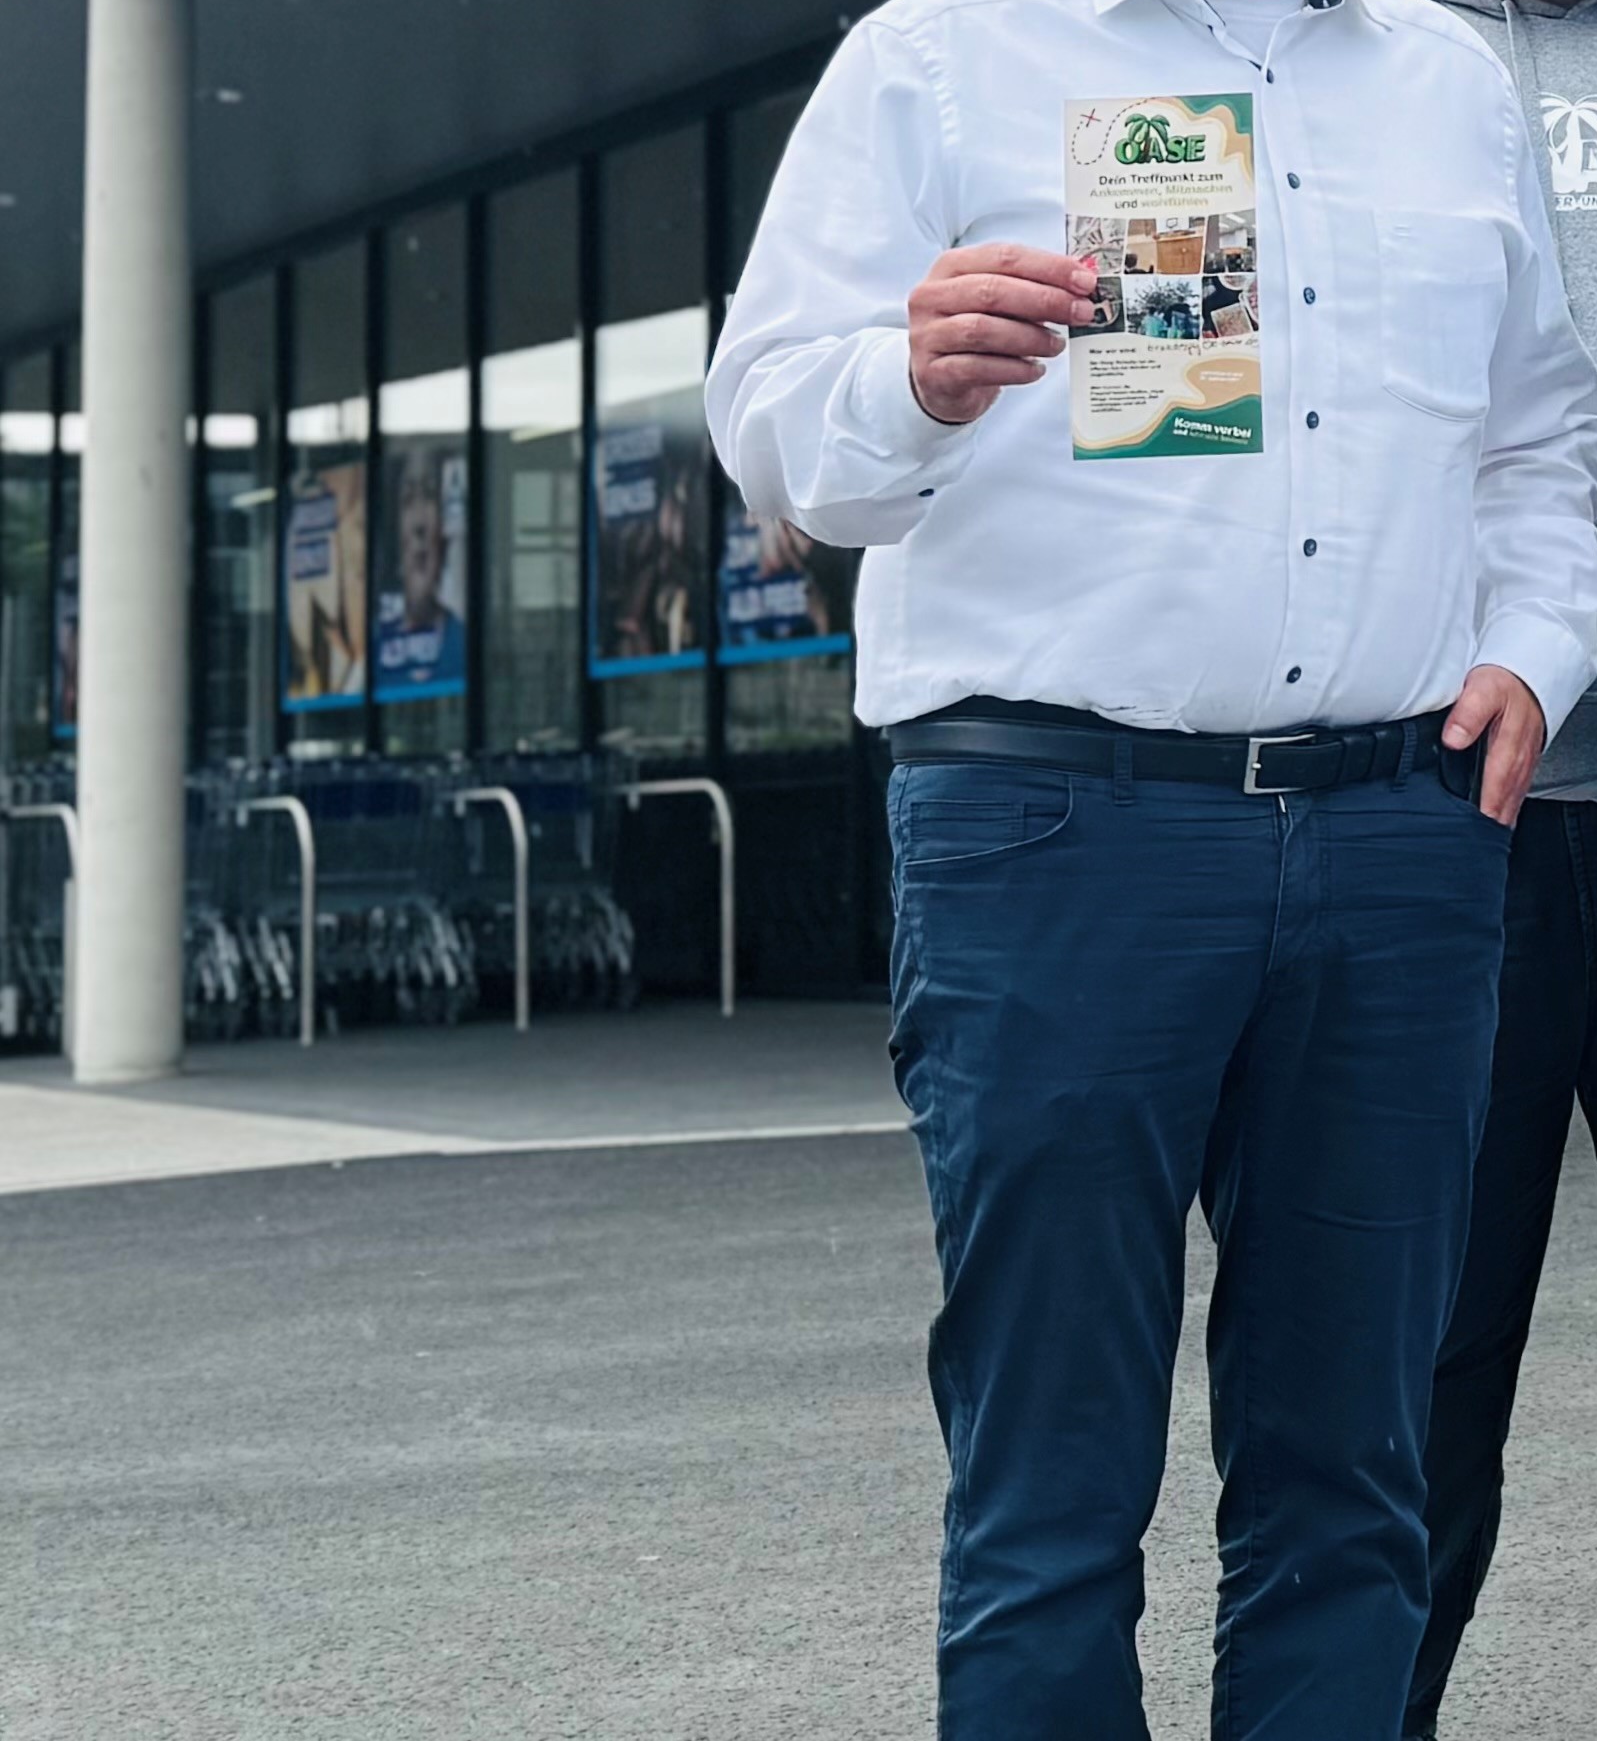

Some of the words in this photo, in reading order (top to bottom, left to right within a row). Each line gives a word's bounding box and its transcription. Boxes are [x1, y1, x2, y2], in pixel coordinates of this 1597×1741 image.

[1114, 134, 1207, 165] OASE
[1099, 175, 1127, 186] Dein
[1130, 173, 1194, 185] Treffpunkt
[1198, 173, 1224, 182] zum
[1114, 199, 1138, 209] und
[1174, 416, 1213, 433] Komm
